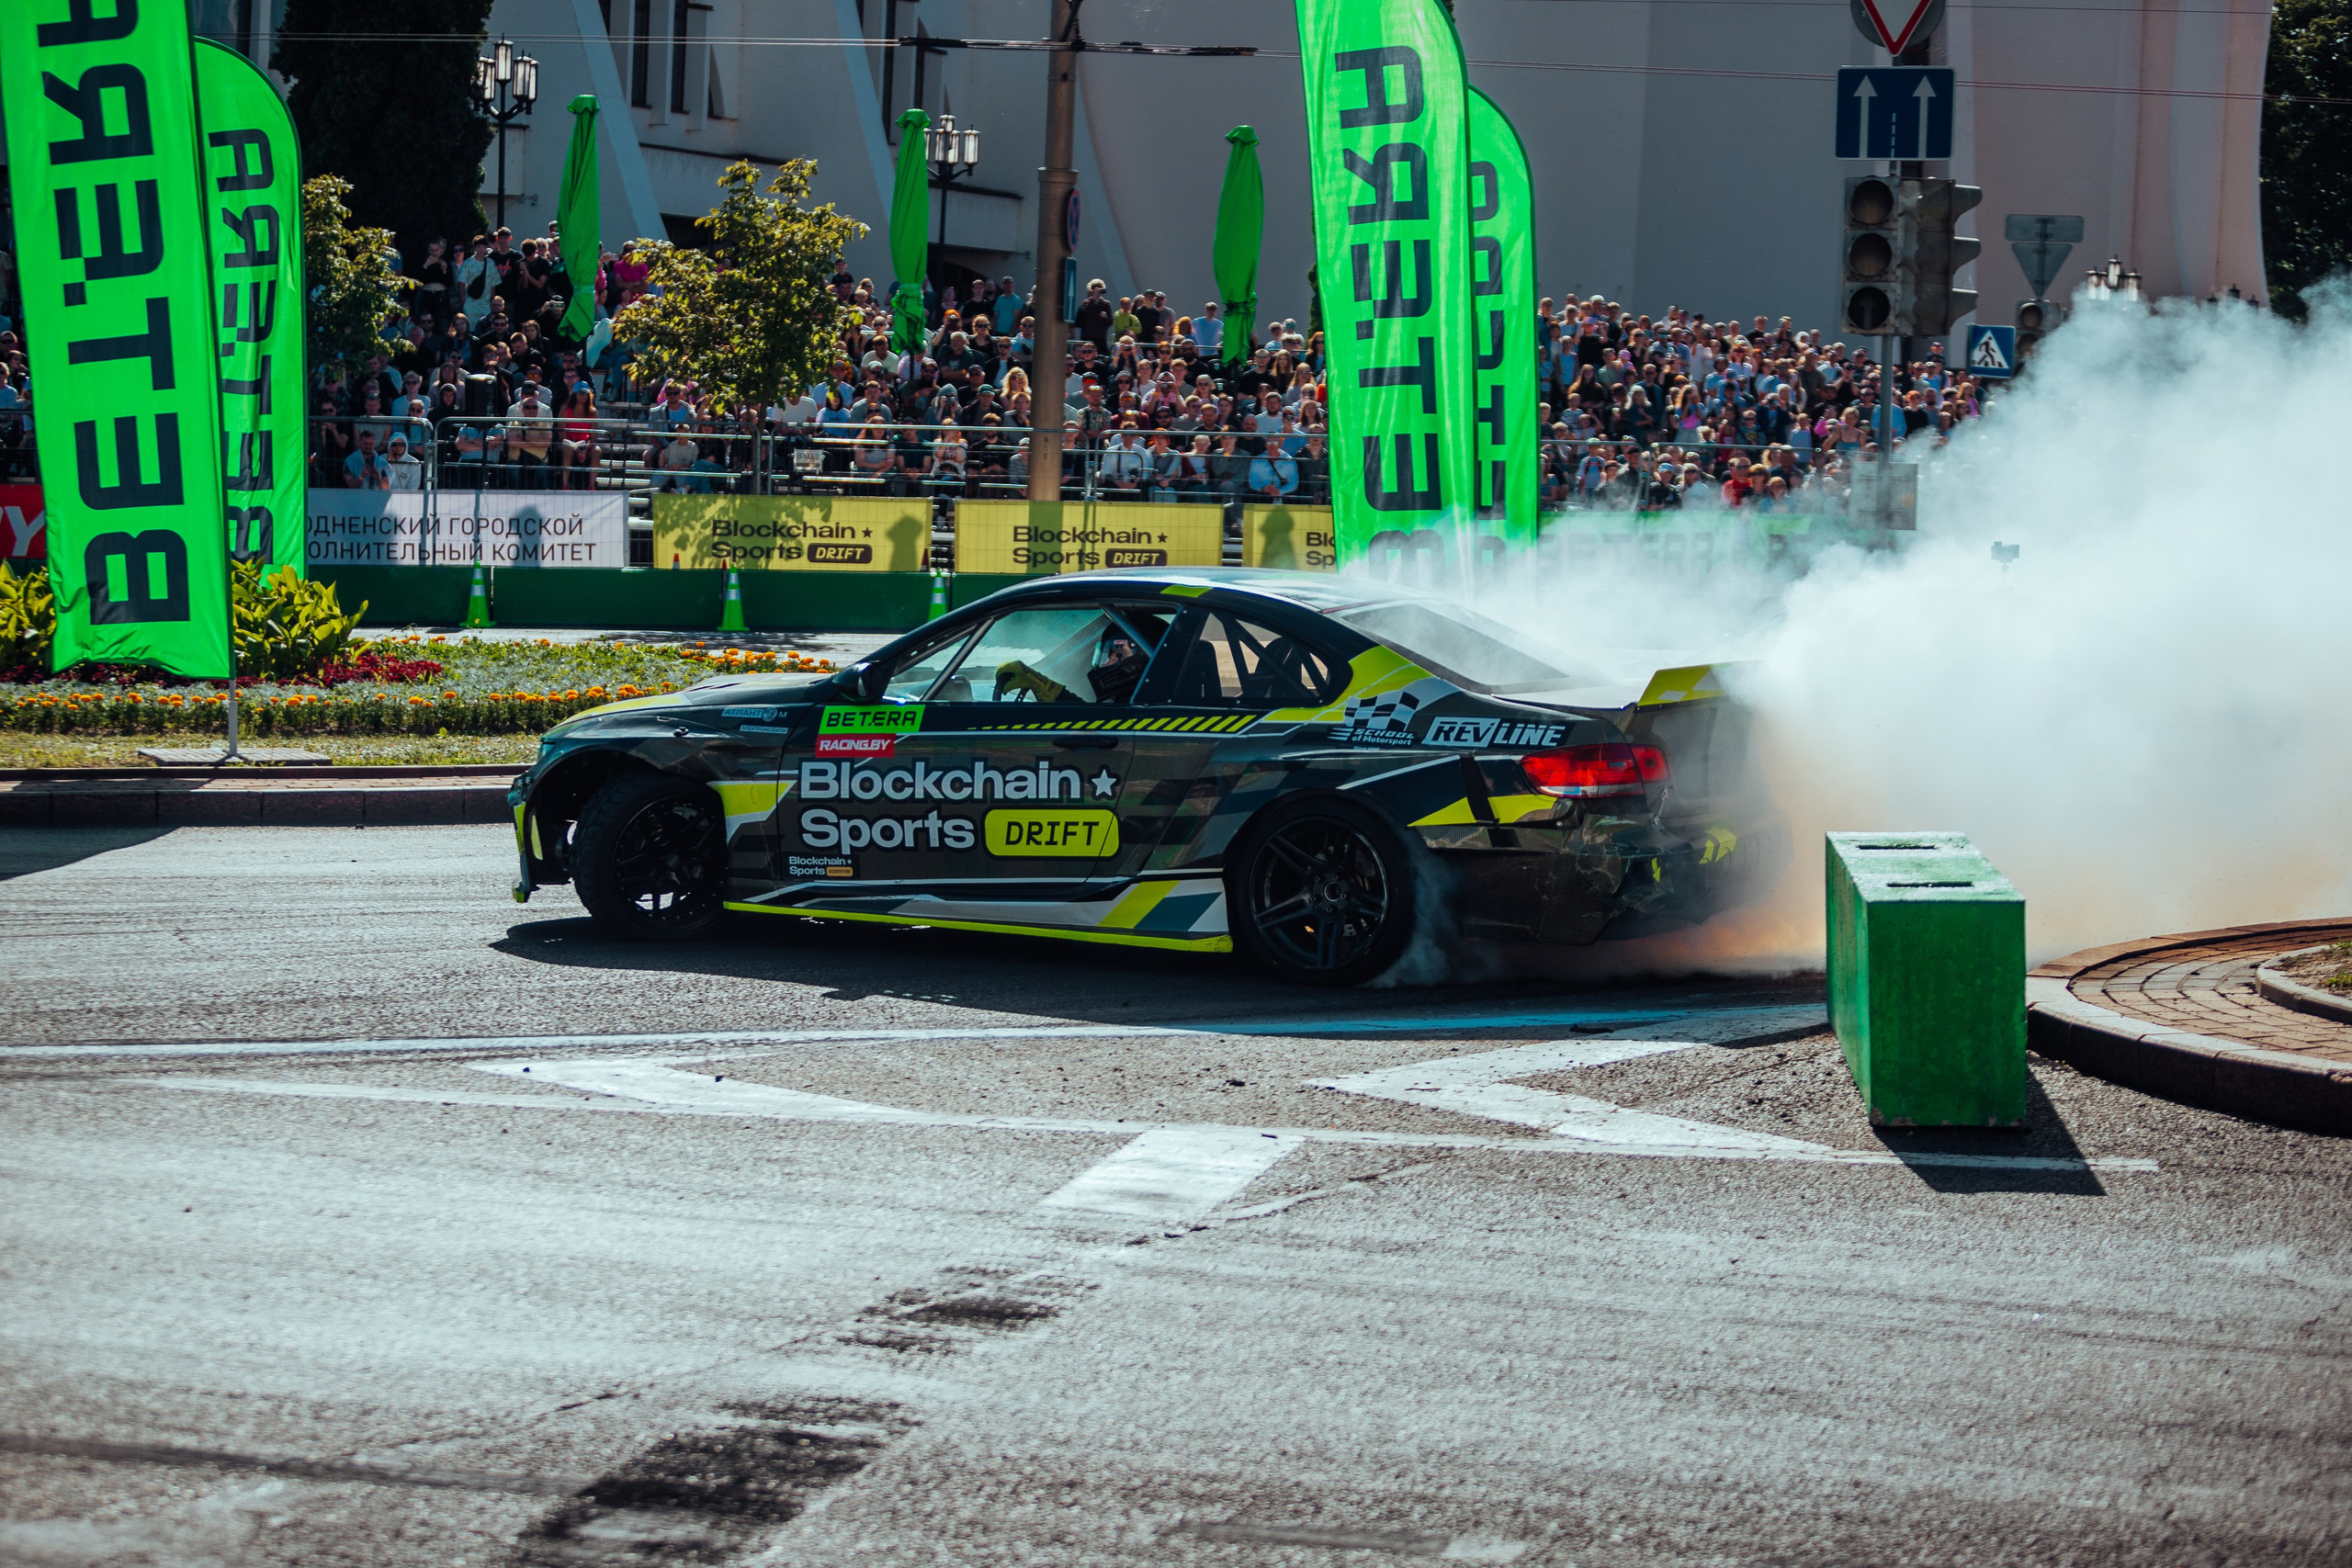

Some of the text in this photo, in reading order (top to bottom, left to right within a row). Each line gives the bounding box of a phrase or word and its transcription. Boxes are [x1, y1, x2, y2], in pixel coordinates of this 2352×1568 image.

[450, 513, 583, 538] ГОРОДСКОЙ
[712, 519, 855, 538] Blockchain
[1013, 525, 1152, 545] Blockchain
[493, 543, 596, 561] КОМИТЕТ
[712, 540, 865, 562] Sports DRIFT
[1012, 547, 1159, 568] Sports DRIFT
[1354, 728, 1415, 739] SCHOOL
[1363, 736, 1412, 745] Motorsport
[819, 739, 890, 750] RACING.BY
[801, 761, 1081, 799] Blockchain
[800, 808, 1100, 855] Sports DRIFT
[788, 856, 846, 865] Blockchain
[789, 865, 825, 876] Sports
